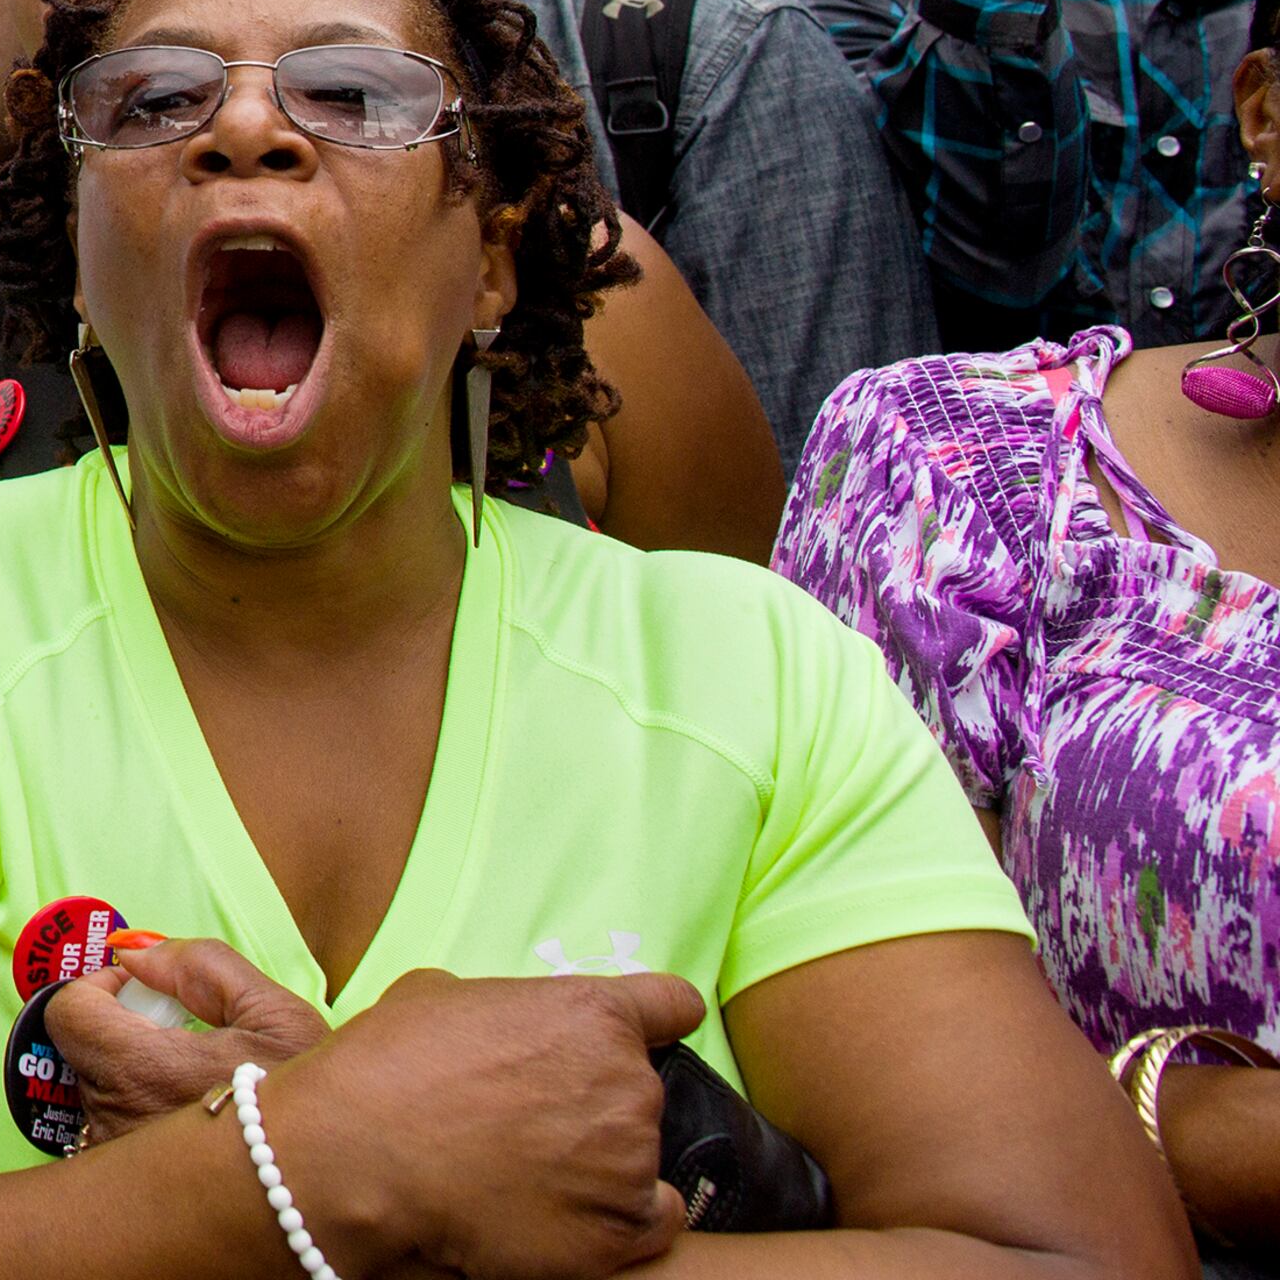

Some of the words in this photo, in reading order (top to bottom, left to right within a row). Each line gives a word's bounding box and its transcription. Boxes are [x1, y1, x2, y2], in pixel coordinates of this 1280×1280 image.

[81, 909, 110, 976] GARNER
[58, 942, 82, 981] FOR
[18, 1052, 56, 1081] GO
[31, 1117, 55, 1141] Eric
[43, 1103, 75, 1126] Justice
